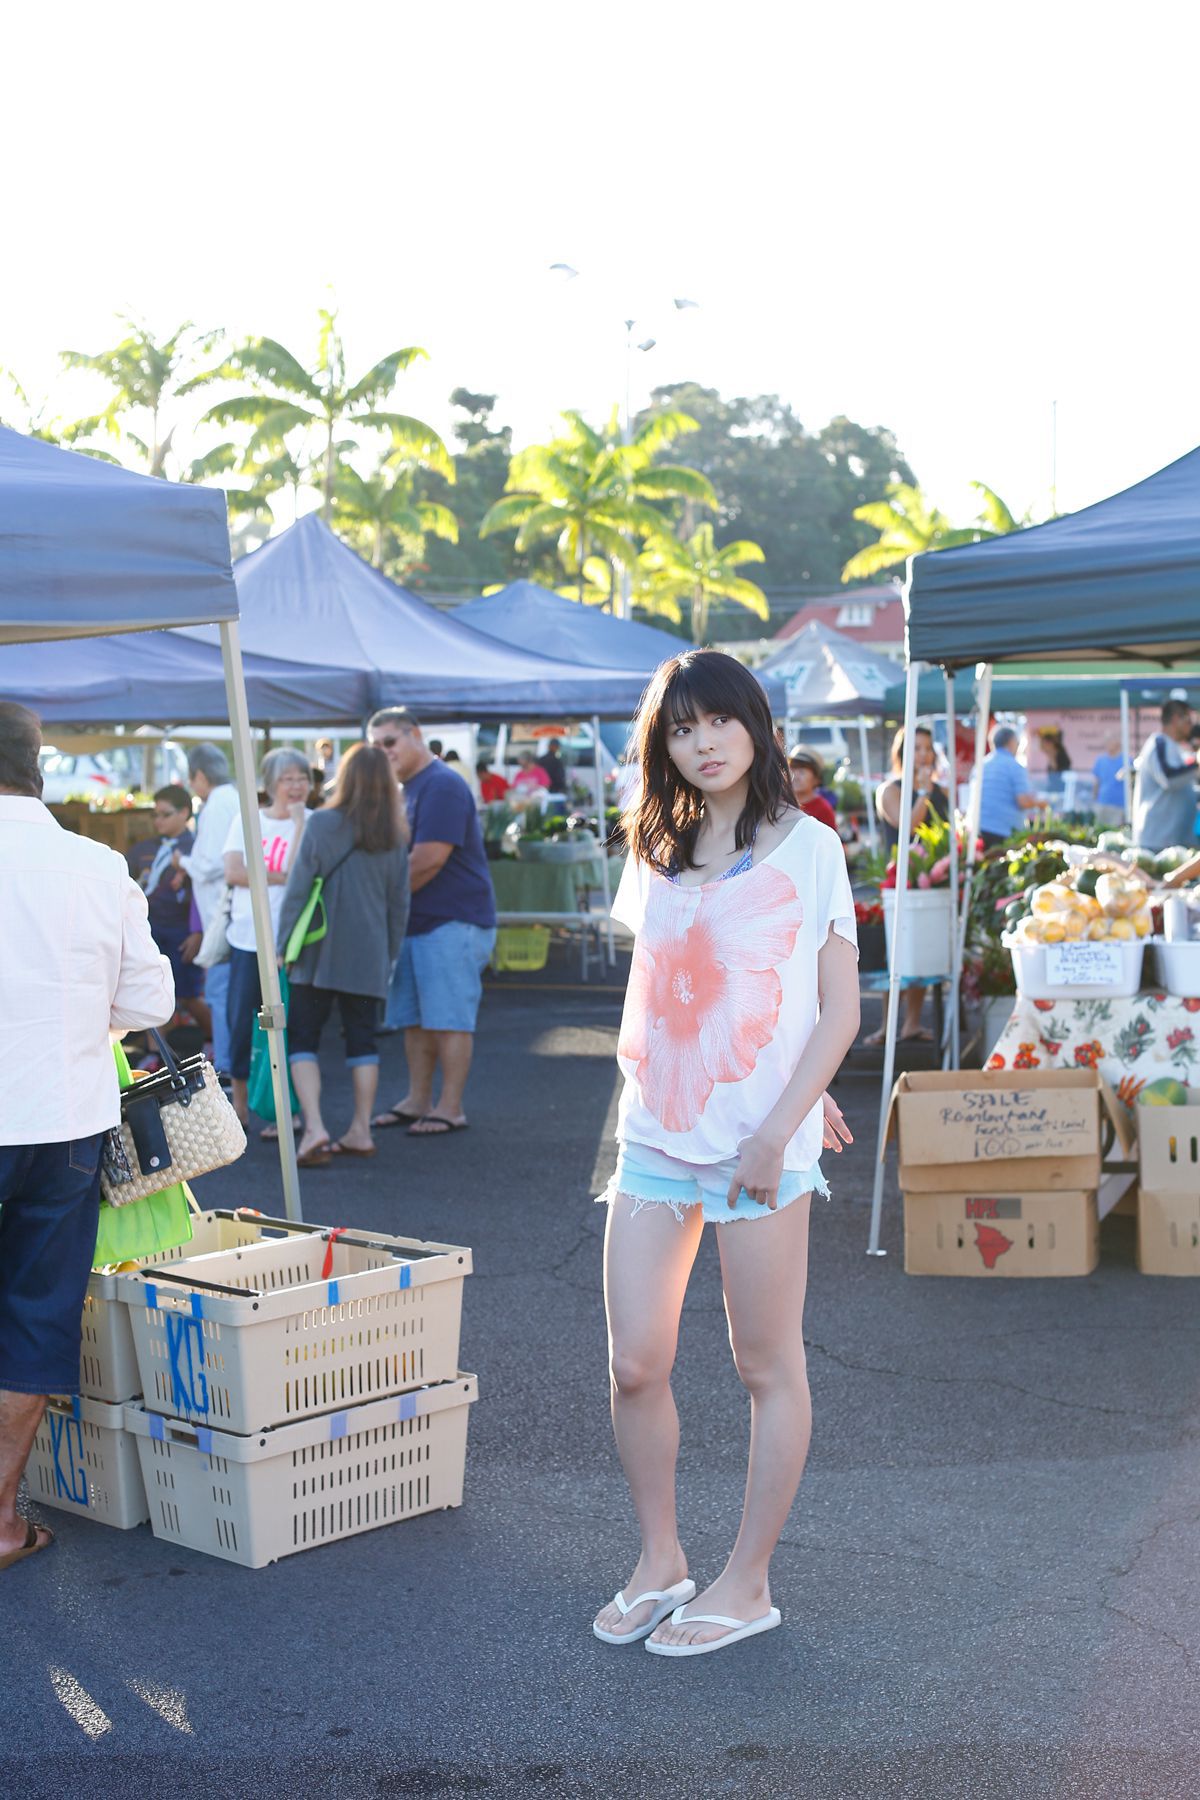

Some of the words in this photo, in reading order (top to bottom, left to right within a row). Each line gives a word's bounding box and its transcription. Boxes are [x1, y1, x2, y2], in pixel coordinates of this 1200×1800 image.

[963, 1089, 1034, 1109] SALE
[166, 1311, 210, 1418] KG
[50, 1410, 88, 1506] KG
